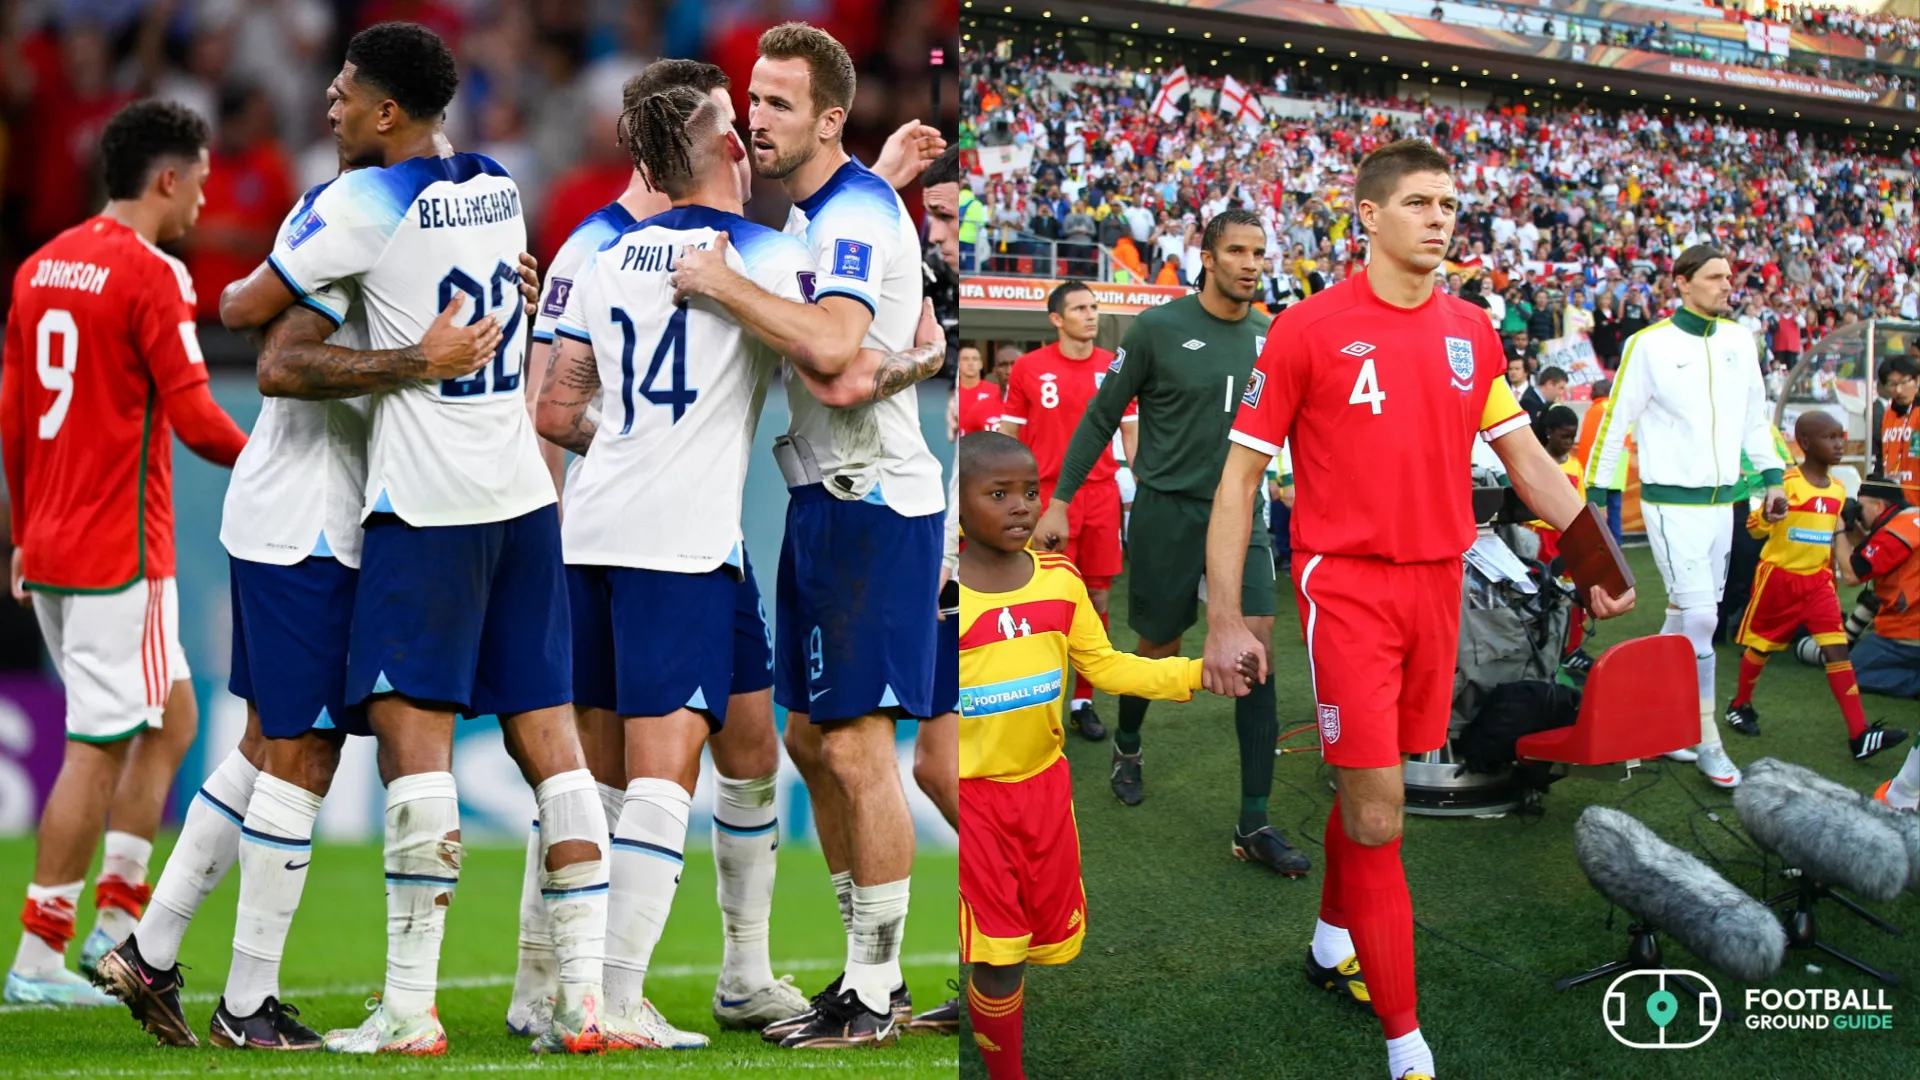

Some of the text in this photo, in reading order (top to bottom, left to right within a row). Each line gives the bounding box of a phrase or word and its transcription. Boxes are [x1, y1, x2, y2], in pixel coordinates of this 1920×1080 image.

[418, 188, 520, 229] BELLINGHAM
[30, 259, 110, 295] JOHNSON
[959, 284, 986, 298] IFA
[988, 285, 1045, 300] WORLD
[1126, 292, 1173, 306] AFRICA
[438, 258, 524, 397] 22
[36, 308, 78, 440] 9
[609, 305, 699, 436] 14
[1348, 358, 1386, 415] 4
[1041, 381, 1059, 409] 8
[1224, 375, 1234, 412] 1
[810, 625, 823, 680] 9
[974, 687, 1031, 706] FOOTBALL
[1033, 682, 1051, 695] FOR
